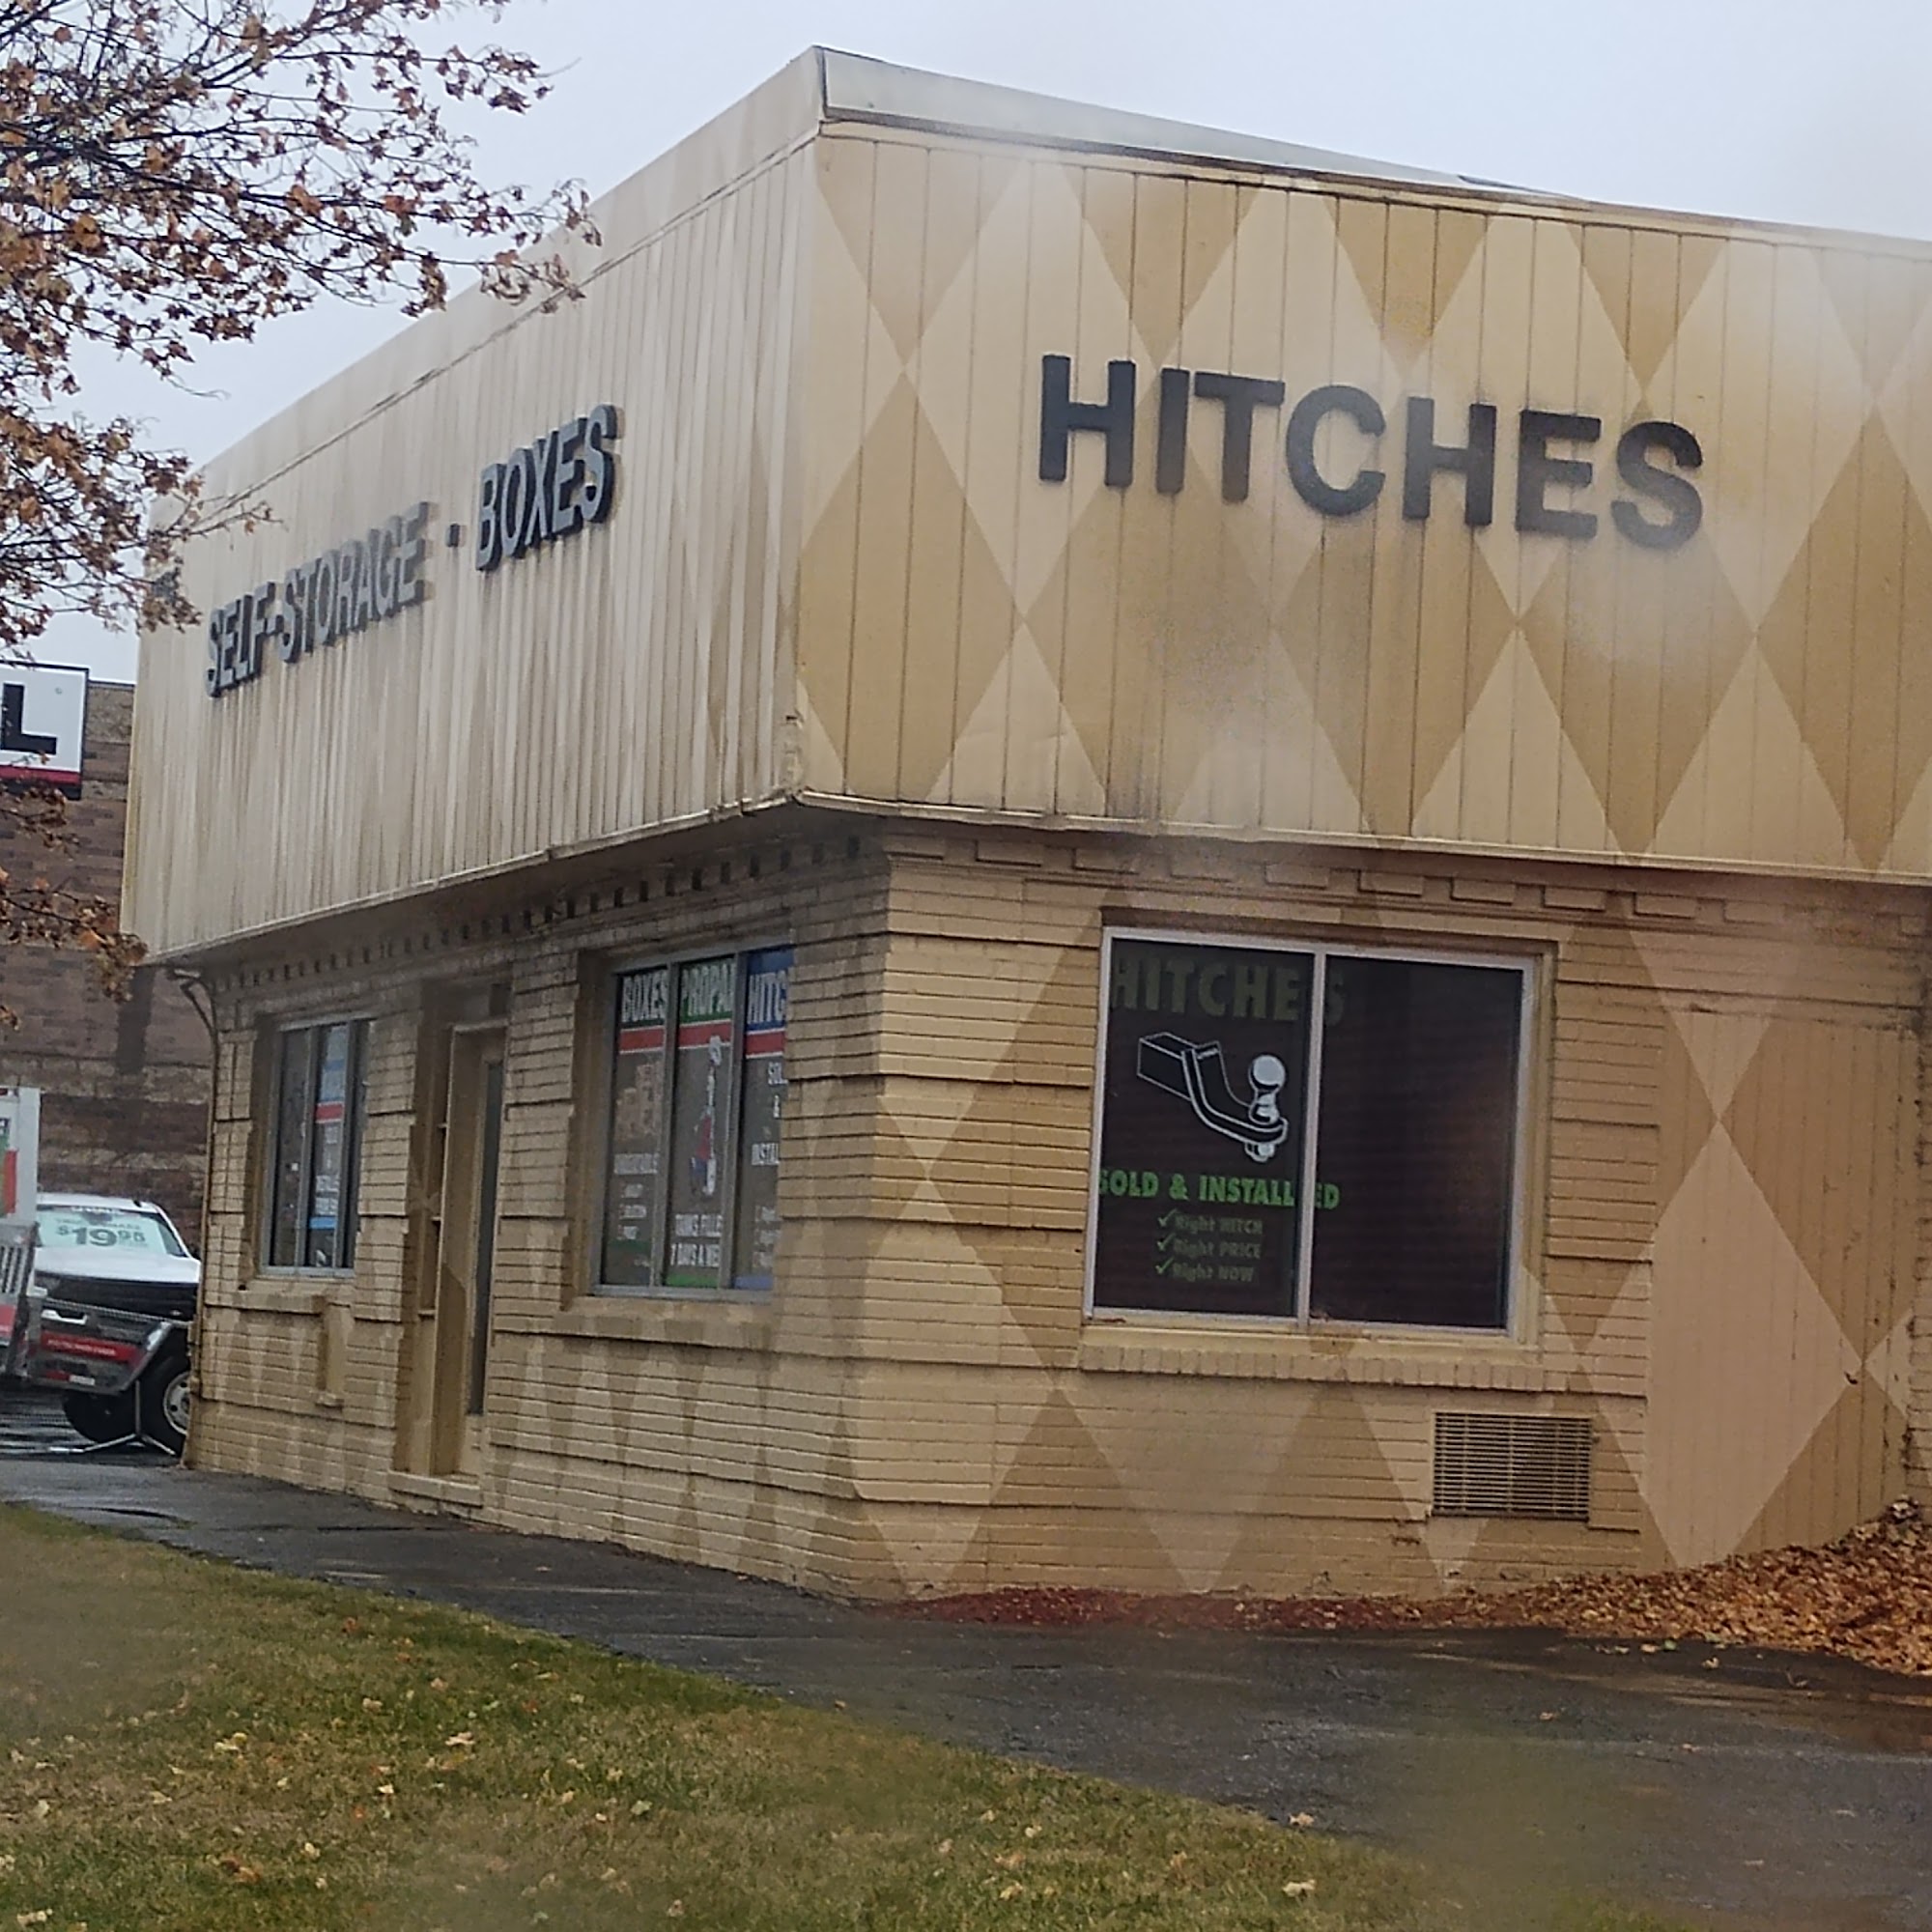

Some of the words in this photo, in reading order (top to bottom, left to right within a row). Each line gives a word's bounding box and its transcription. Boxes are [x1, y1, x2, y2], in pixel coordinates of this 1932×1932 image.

[1038, 354, 1704, 550] HITCHES
[205, 500, 433, 698] SELF-STORAGE
[476, 403, 619, 572] BOXES
[621, 969, 668, 1023] BOXES
[1168, 1173, 1190, 1201] &
[1219, 1219, 1264, 1236] HITCH
[1219, 1241, 1262, 1260] PRICE
[1218, 1265, 1255, 1283] NOW
